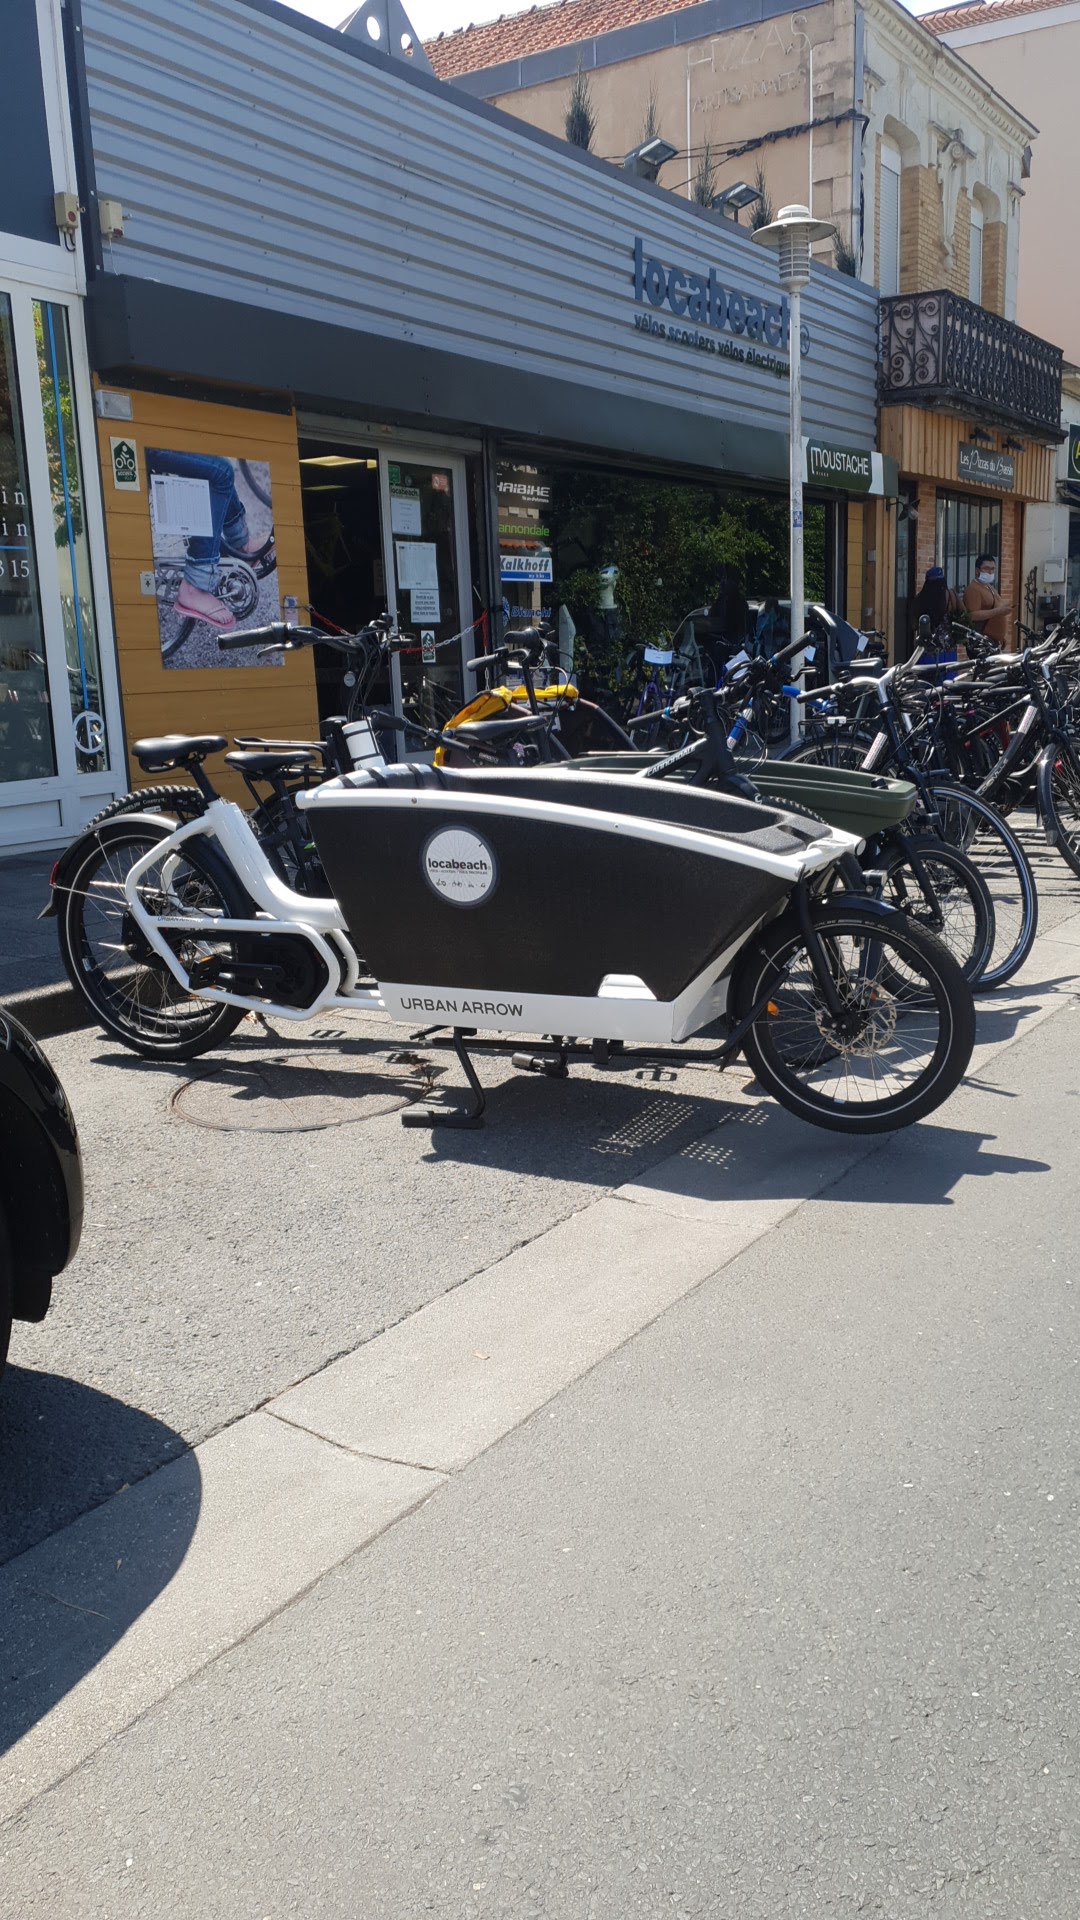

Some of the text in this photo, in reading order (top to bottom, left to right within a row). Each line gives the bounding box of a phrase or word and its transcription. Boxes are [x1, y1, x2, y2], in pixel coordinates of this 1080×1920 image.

[634, 313, 665, 339] vélos
[669, 325, 715, 353] scooters
[718, 339, 745, 363] vélos
[811, 447, 869, 475] MOUSTACHE
[960, 450, 969, 465] Les
[969, 449, 989, 470] Pizzas
[989, 459, 996, 471] du
[996, 456, 1014, 476] Bassin
[11, 559, 30, 578] 15
[500, 557, 549, 572] Kalkhoff
[511, 605, 552, 618] Bianchi
[428, 858, 488, 870] locabeach
[401, 998, 523, 1016] URBAN ARROW
